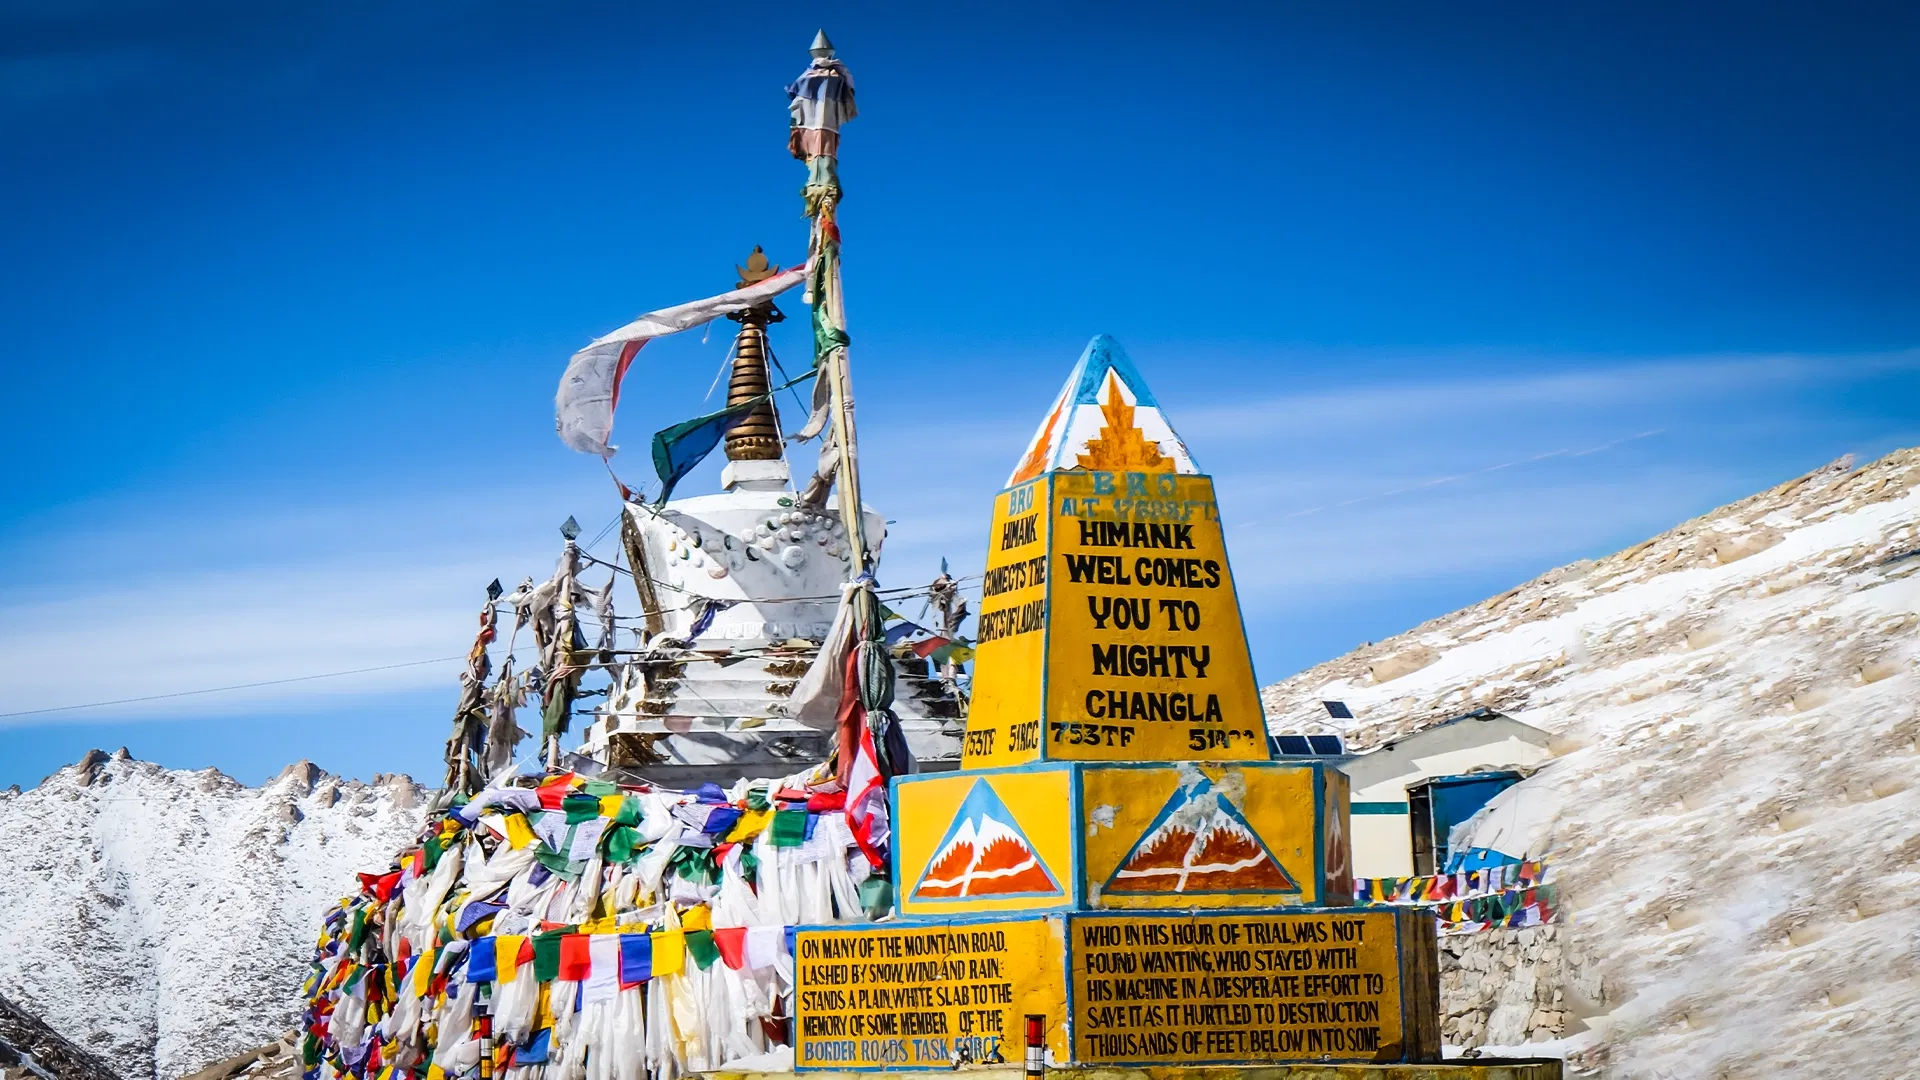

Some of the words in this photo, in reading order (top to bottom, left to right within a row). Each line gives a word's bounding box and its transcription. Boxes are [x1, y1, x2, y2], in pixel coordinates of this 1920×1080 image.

[1092, 471, 1177, 496] BRO
[1008, 485, 1034, 516] BRO
[1001, 513, 1038, 551] HIMANK
[1078, 520, 1196, 549] HIMANK
[983, 560, 1027, 598] CONNECTS
[1029, 555, 1046, 587] THE
[976, 609, 1006, 645] HEARTS
[1006, 607, 1018, 636] OF
[1016, 598, 1046, 635] LADAKH
[1087, 596, 1152, 631] YOU
[1160, 600, 1200, 631] TO
[1091, 643, 1211, 679] MIGHTY
[1085, 689, 1223, 722] CHANGLA
[964, 728, 996, 756] 753TF
[1051, 722, 1136, 747] 753TF
[802, 939, 819, 959] ON
[822, 937, 857, 959] MANY
[859, 937, 874, 958] OF
[877, 937, 902, 958] THE
[904, 933, 970, 957] MOUNTAIN
[1082, 925, 1121, 947] WHO
[1124, 924, 1140, 946] IN
[1142, 924, 1169, 946] HIS
[1171, 923, 1215, 945] HOUR
[1219, 924, 1240, 945] OF
[1332, 920, 1365, 942] NOT
[802, 964, 848, 986] LASHED
[852, 964, 867, 984] BY
[942, 960, 965, 980] AND
[1085, 952, 1137, 974] FOUND
[1254, 948, 1312, 971] STAYED
[1315, 947, 1357, 970] WITH
[802, 990, 846, 1011] STANDS
[848, 990, 857, 1010] A
[936, 986, 970, 1006] SLAB
[971, 985, 987, 1004] TO
[988, 983, 1012, 1004] THE
[1087, 979, 1112, 1002] HIS
[1115, 977, 1178, 1001] MACHINE
[1182, 977, 1196, 998] IN
[1199, 976, 1211, 998] A
[1213, 975, 1300, 999] DESPERATE
[1304, 974, 1360, 997] EFFORT
[1363, 973, 1384, 995] TO
[803, 1015, 847, 1037] MEMORY
[850, 1014, 865, 1036] OF
[867, 1013, 898, 1036] SOME
[900, 1012, 948, 1035] MEMBER
[959, 1010, 974, 1033] OF
[976, 1009, 1003, 1032] THE
[1087, 1006, 1126, 1029] SAVE
[1129, 1005, 1143, 1027] IT
[1143, 1005, 1164, 1027] AS
[1166, 1004, 1180, 1026] IT
[1183, 1003, 1251, 1026] HURTLED
[1254, 1003, 1275, 1024] TO
[1278, 1001, 1379, 1024] DESTRUCTION
[804, 1040, 856, 1061] BORDER
[861, 1038, 908, 1062] ROADS
[912, 1037, 949, 1061] TASK
[1085, 1031, 1178, 1057] THOUSANDS
[1182, 1031, 1203, 1054] OF
[1250, 1029, 1304, 1053] BELOW
[1346, 1026, 1382, 1052] SOME
